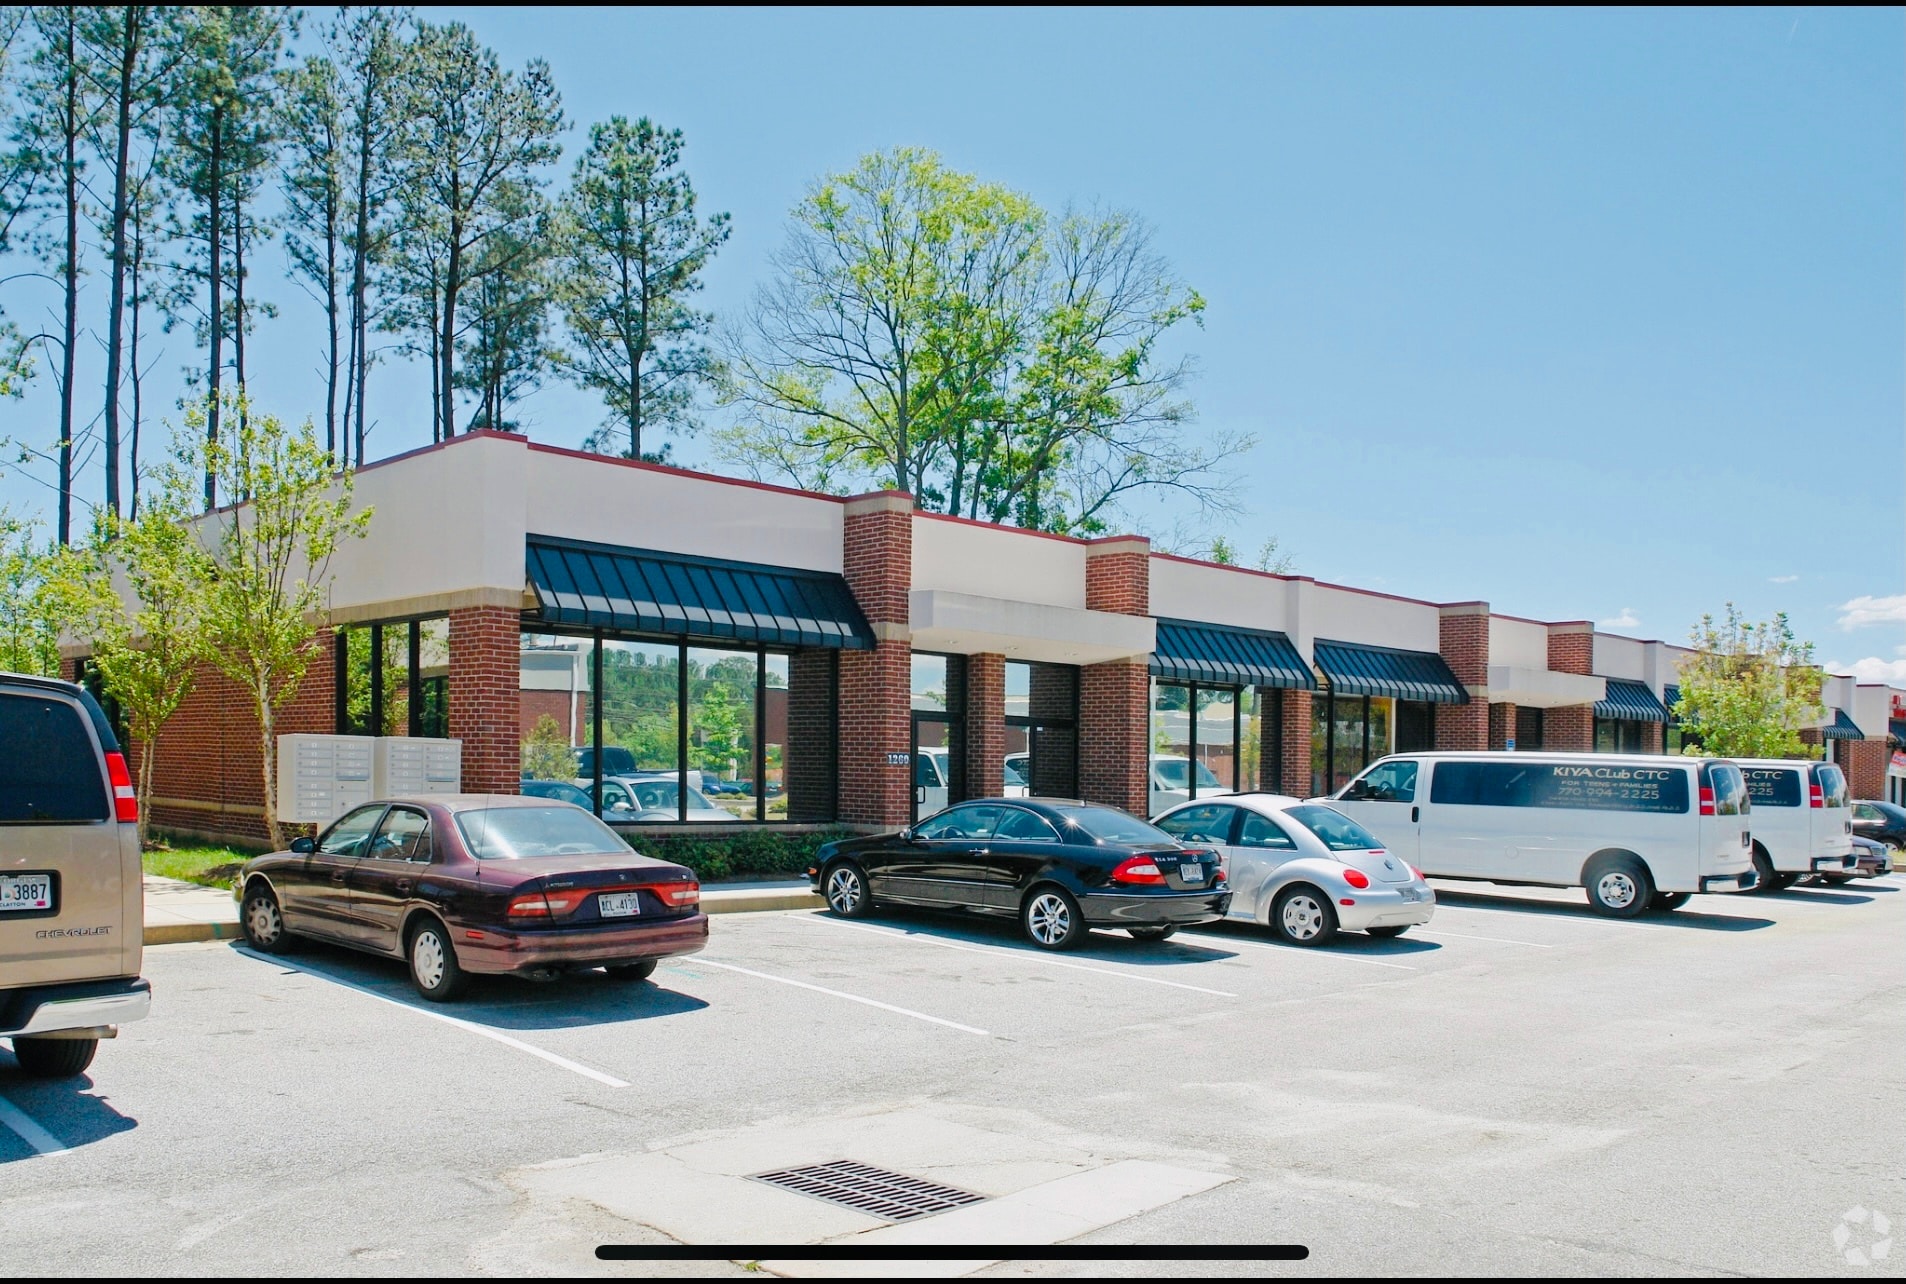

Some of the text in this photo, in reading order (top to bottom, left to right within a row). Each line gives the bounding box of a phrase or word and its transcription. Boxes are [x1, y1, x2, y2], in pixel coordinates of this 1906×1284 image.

[888, 754, 909, 764] 1260
[1553, 766, 1593, 777] KIYA
[1633, 769, 1670, 780] CTC
[1752, 770, 1783, 779] CTC
[35, 925, 113, 939] CHEVROLET
